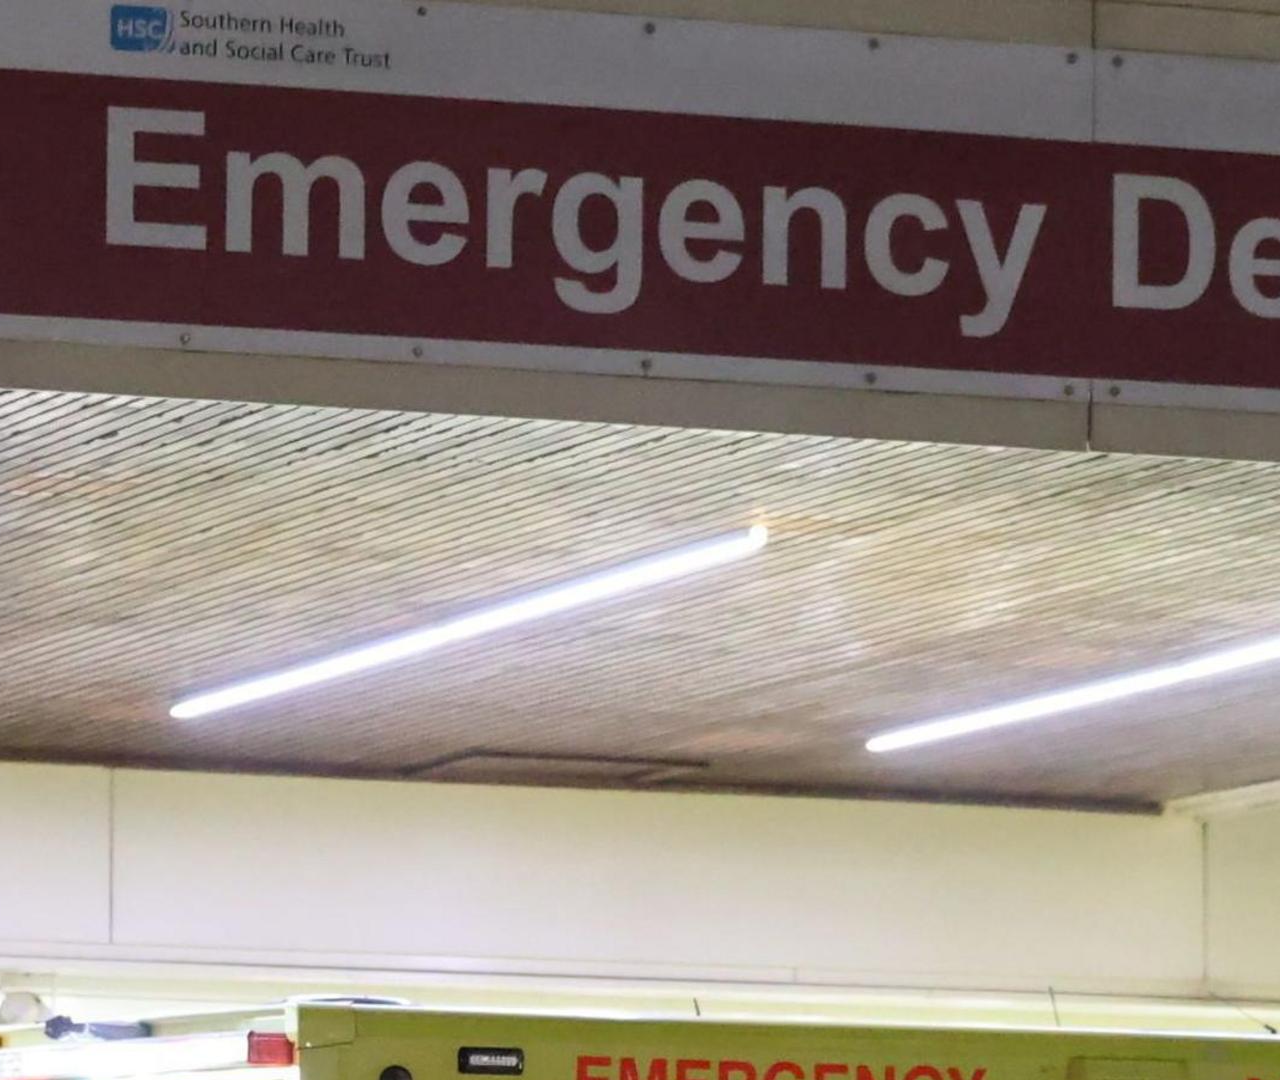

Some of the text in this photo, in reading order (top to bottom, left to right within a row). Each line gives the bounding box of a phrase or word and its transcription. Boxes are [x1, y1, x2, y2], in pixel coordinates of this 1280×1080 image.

[117, 19, 161, 38] HSC
[180, 10, 345, 38] Southern Health
[180, 39, 391, 70] and Social Care Trust
[104, 104, 1048, 340] Emergency
